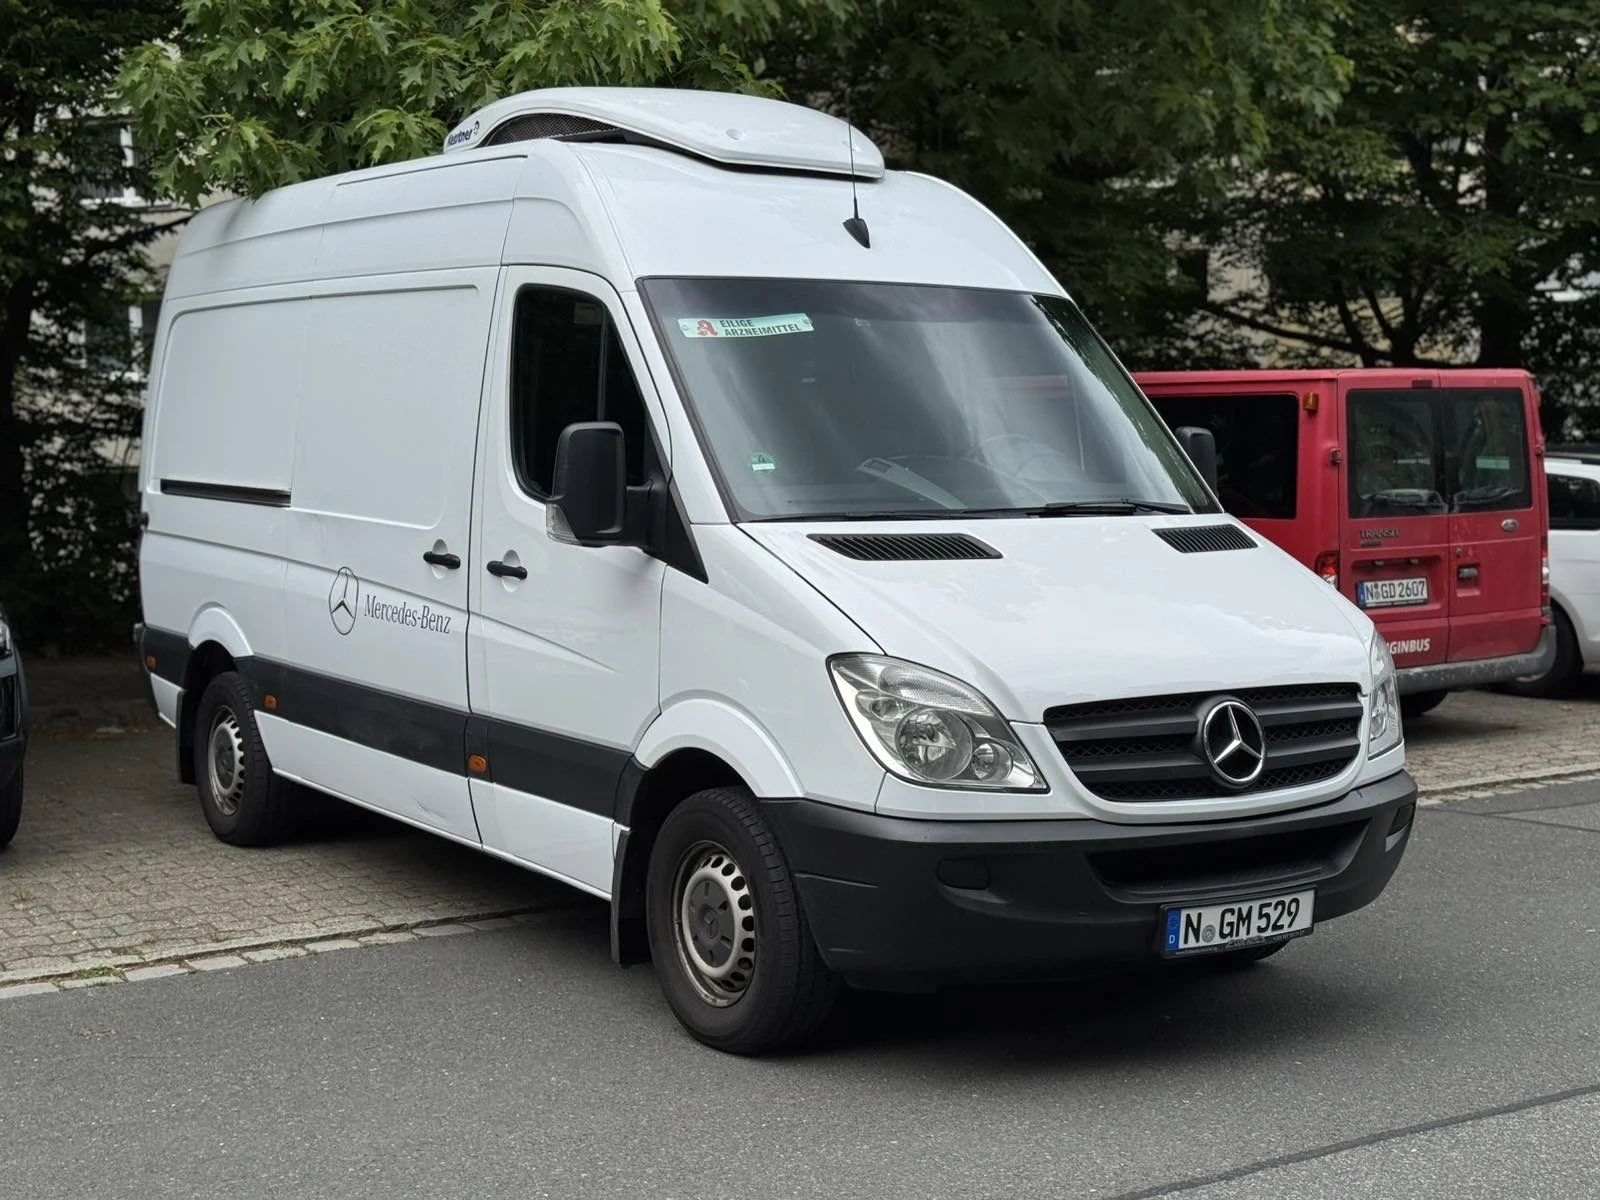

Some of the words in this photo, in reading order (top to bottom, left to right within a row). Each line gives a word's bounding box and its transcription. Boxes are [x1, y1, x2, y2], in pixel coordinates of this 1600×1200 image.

[719, 319, 755, 328] EILIGE
[724, 323, 802, 336] ARZNEIMITTEL
[1365, 583, 1374, 600] N
[1381, 582, 1396, 599] GD
[1398, 580, 1425, 598] 2607
[364, 594, 452, 635] Mercedes-Benz
[1387, 638, 1431, 655] GINBUS
[1183, 912, 1203, 945] N
[1218, 905, 1253, 940] GM
[1256, 897, 1301, 934] 529
[1168, 934, 1176, 944] D
